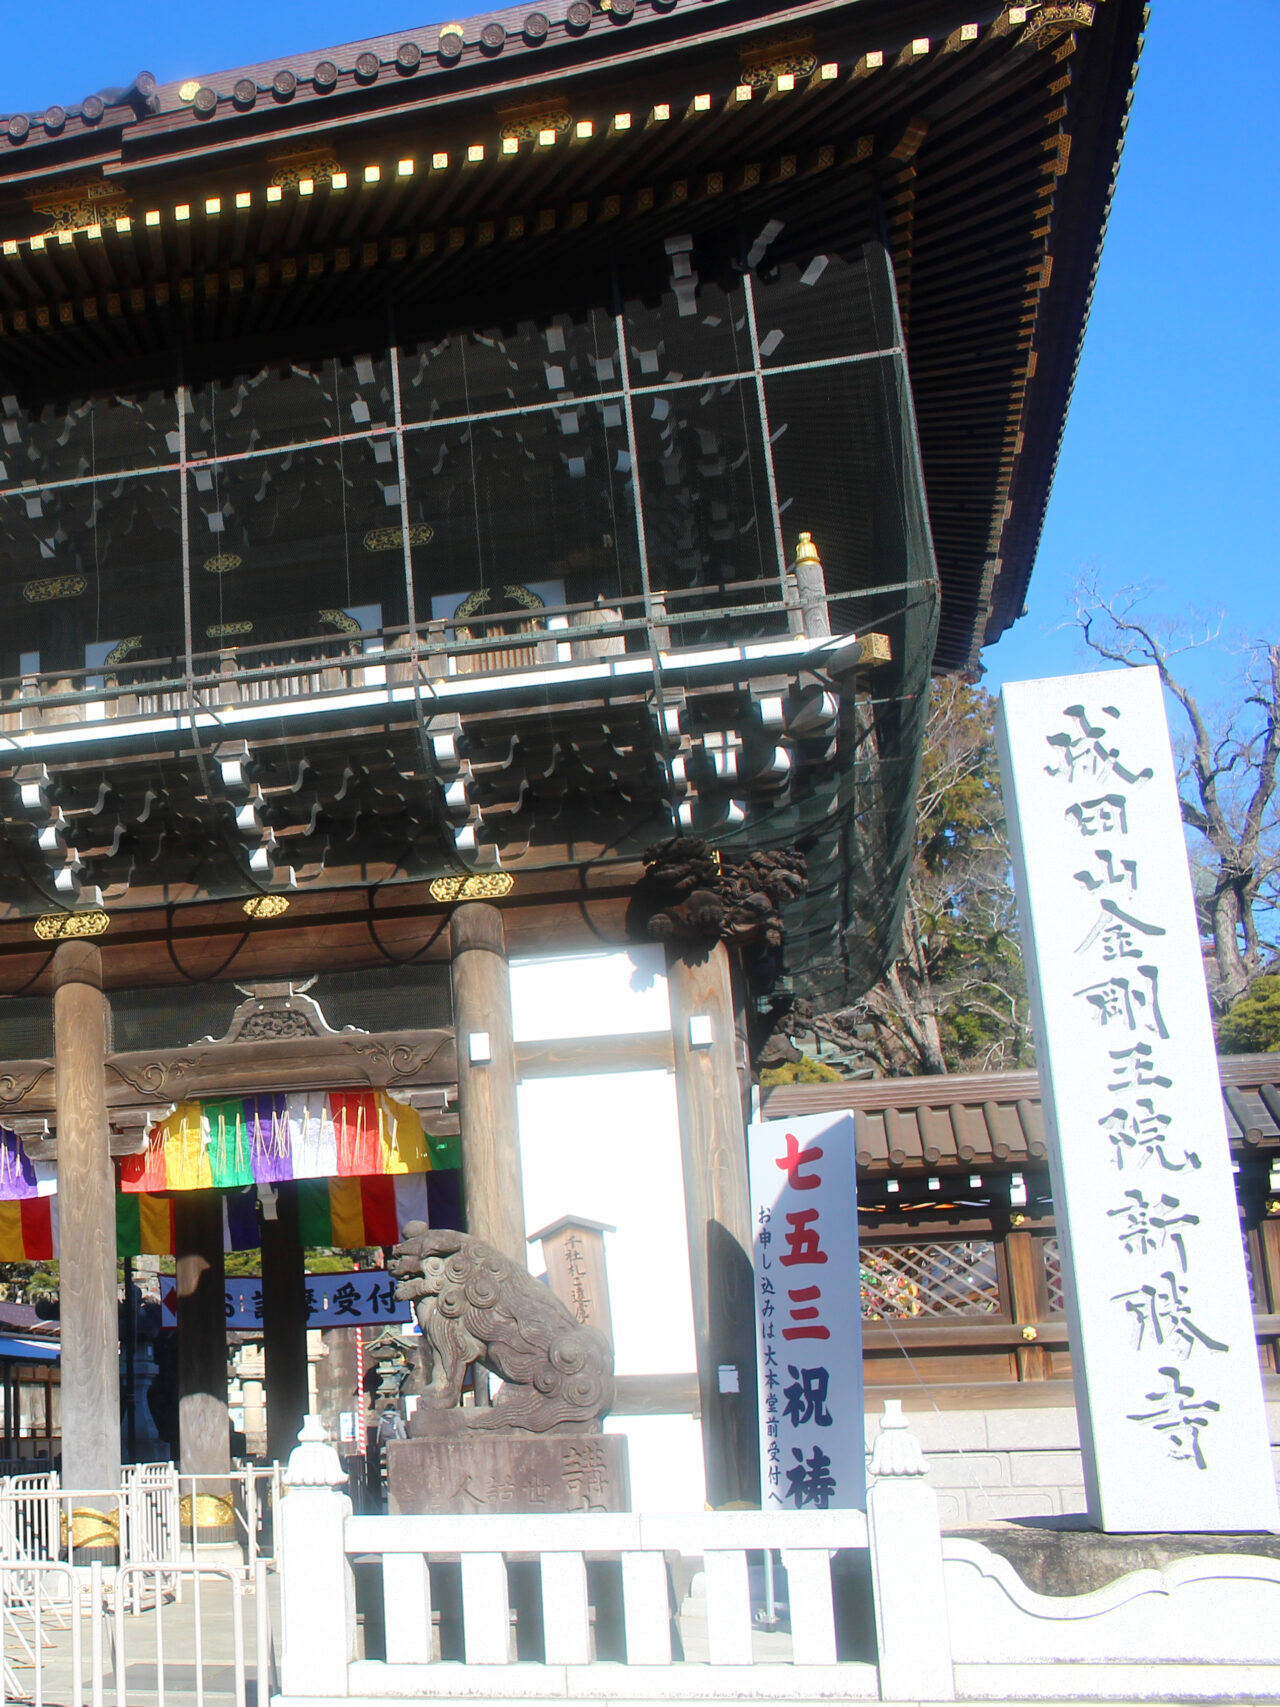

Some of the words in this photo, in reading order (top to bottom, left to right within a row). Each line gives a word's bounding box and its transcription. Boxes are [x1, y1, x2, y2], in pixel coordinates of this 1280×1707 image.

[1043, 704, 1230, 1470] 成田山金剛王院新勝寺
[758, 1205, 784, 1505] お申し込みは大本堂前受付へ
